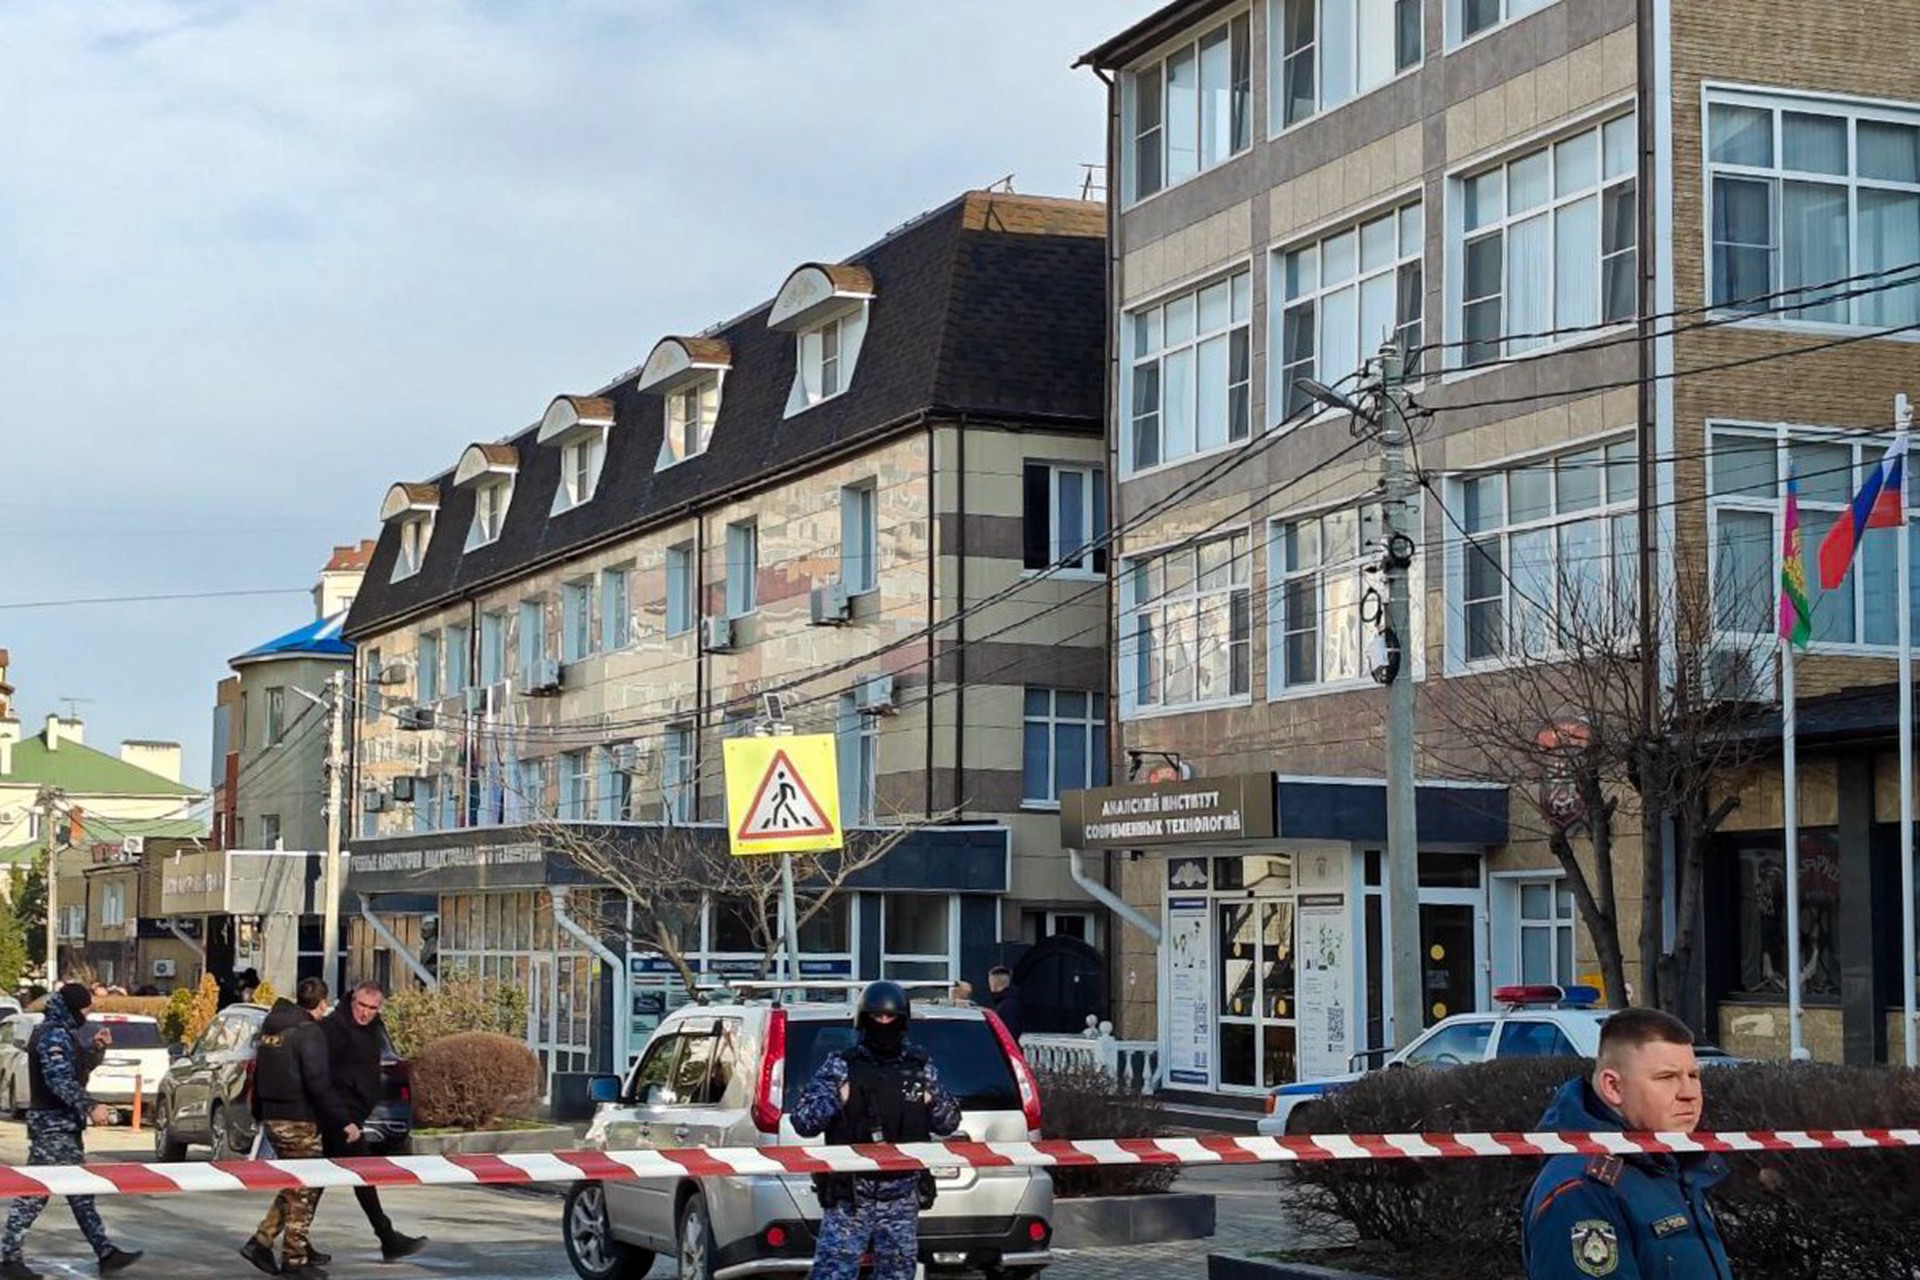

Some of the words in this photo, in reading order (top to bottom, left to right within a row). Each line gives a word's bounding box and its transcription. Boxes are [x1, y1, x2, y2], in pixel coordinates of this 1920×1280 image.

[1102, 793, 1160, 816] АНАПСКИЙ
[1162, 791, 1220, 811] ИНСТИТУТ
[1085, 819, 1164, 839] СОВРЕМЕННЫХ
[1165, 811, 1241, 833] ТЕХНОЛОГИЙ
